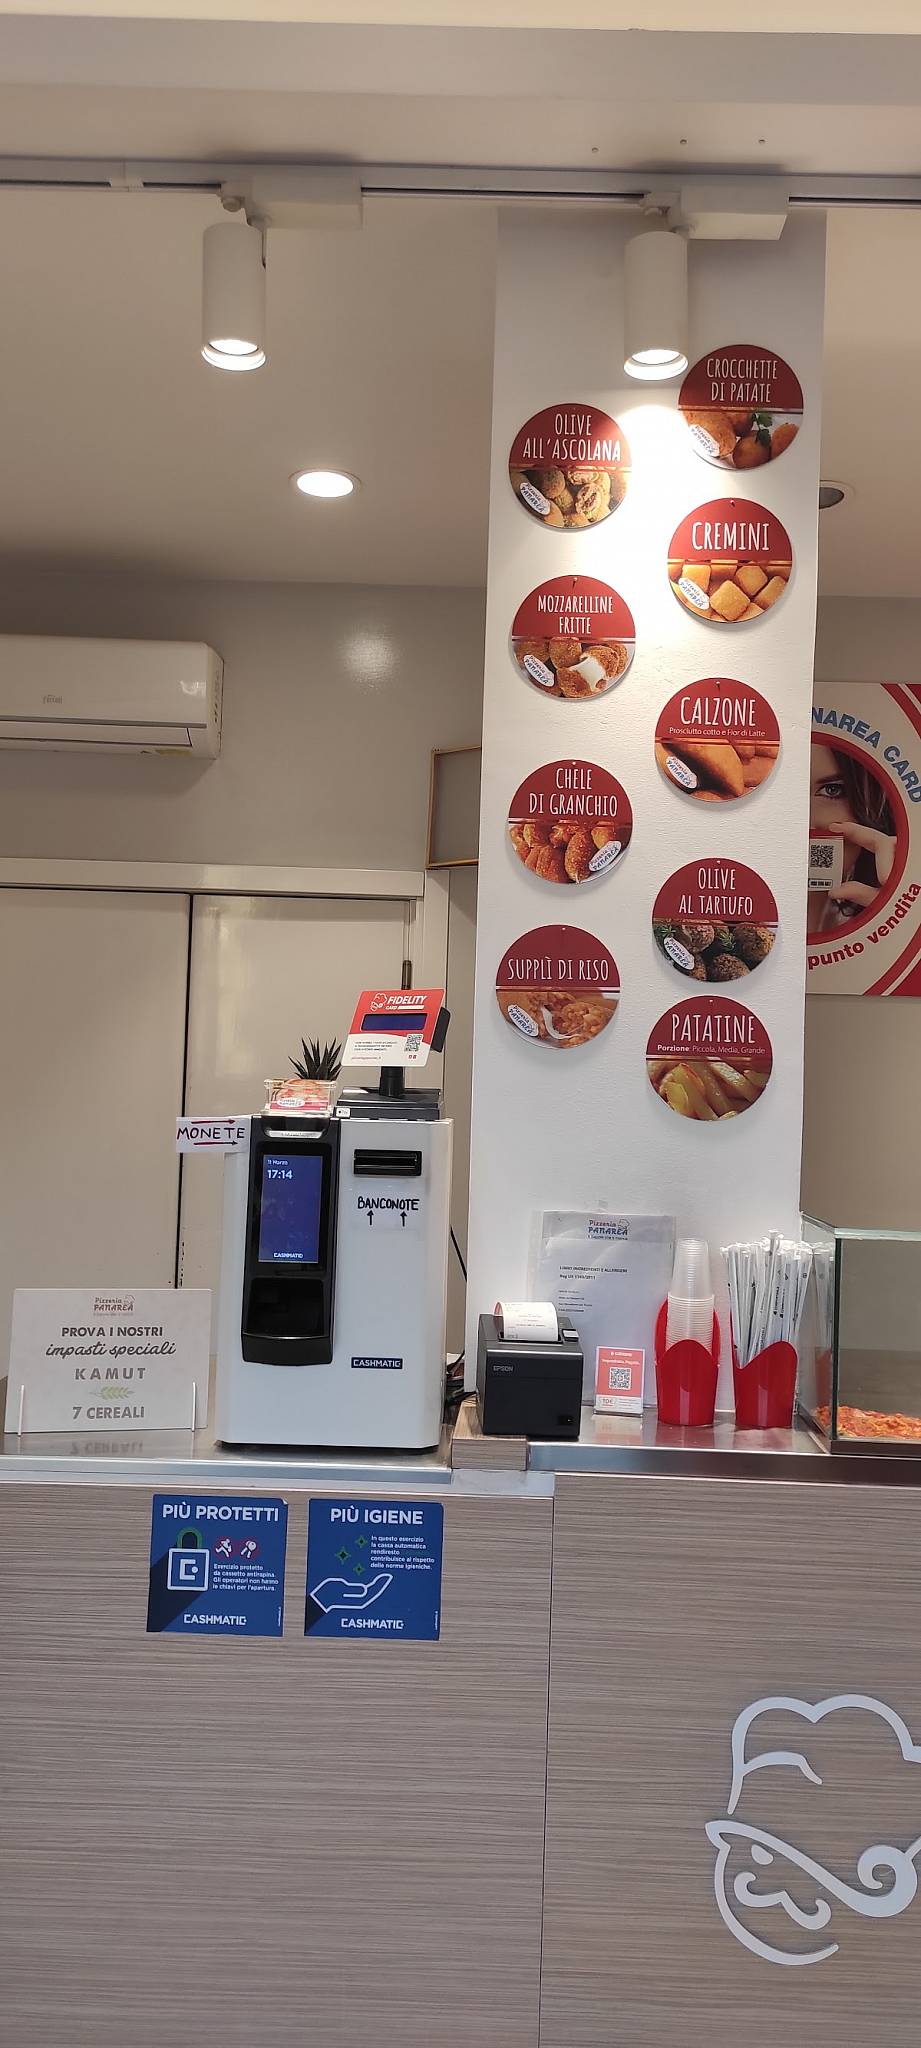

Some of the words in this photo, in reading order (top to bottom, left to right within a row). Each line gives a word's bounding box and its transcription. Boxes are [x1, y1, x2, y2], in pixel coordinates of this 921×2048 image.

[706, 358, 778, 380] CROCCHETTE
[711, 382, 725, 401] DI
[730, 382, 771, 403] PATATE
[554, 413, 592, 436] OLIVE
[522, 437, 621, 462] ALL'ASCOLANA
[692, 521, 770, 551] CREMINI
[537, 594, 613, 614] MOZZARELLINE
[559, 616, 592, 634] FRITTE
[680, 696, 756, 727] CALZONE
[669, 727, 702, 735] Prosciutto
[556, 768, 593, 790] CHELE
[883, 745, 921, 803] CARD
[529, 793, 544, 814] DI
[549, 793, 618, 817] GRANCHIO
[698, 867, 736, 890] OLIVE
[678, 894, 694, 914] AL
[698, 895, 753, 916] TARTUFO
[807, 942, 865, 970] punto
[866, 883, 921, 944] vendita
[507, 956, 552, 980] SUPPLÌ
[558, 959, 573, 980] DI
[579, 959, 609, 981] RISO
[387, 995, 428, 1005] FIDELITY
[672, 1013, 756, 1044] PATATINE
[740, 1046, 766, 1054] Grande
[176, 1126, 246, 1140] MONETE
[267, 1169, 293, 1180] 17:14
[357, 1195, 420, 1211] BANCONOTE
[587, 1226, 628, 1236] PANAREA
[61, 1326, 106, 1337] PROVA
[109, 1326, 114, 1337] I
[117, 1326, 163, 1337] NOSTRI
[46, 1341, 108, 1359] impasti
[109, 1340, 176, 1359] speciali
[75, 1367, 147, 1380] KAMUT
[353, 1359, 401, 1368] CASHMATIC
[72, 1406, 82, 1420] 7
[86, 1406, 145, 1419] CEREALI
[162, 1501, 193, 1519] PIÙ
[195, 1505, 279, 1522] PROTETTI
[330, 1505, 360, 1523] PIÙ
[364, 1509, 424, 1525] IGIENE
[183, 1613, 247, 1626] CASHMATIC
[341, 1618, 404, 1630] CASHMATIC
